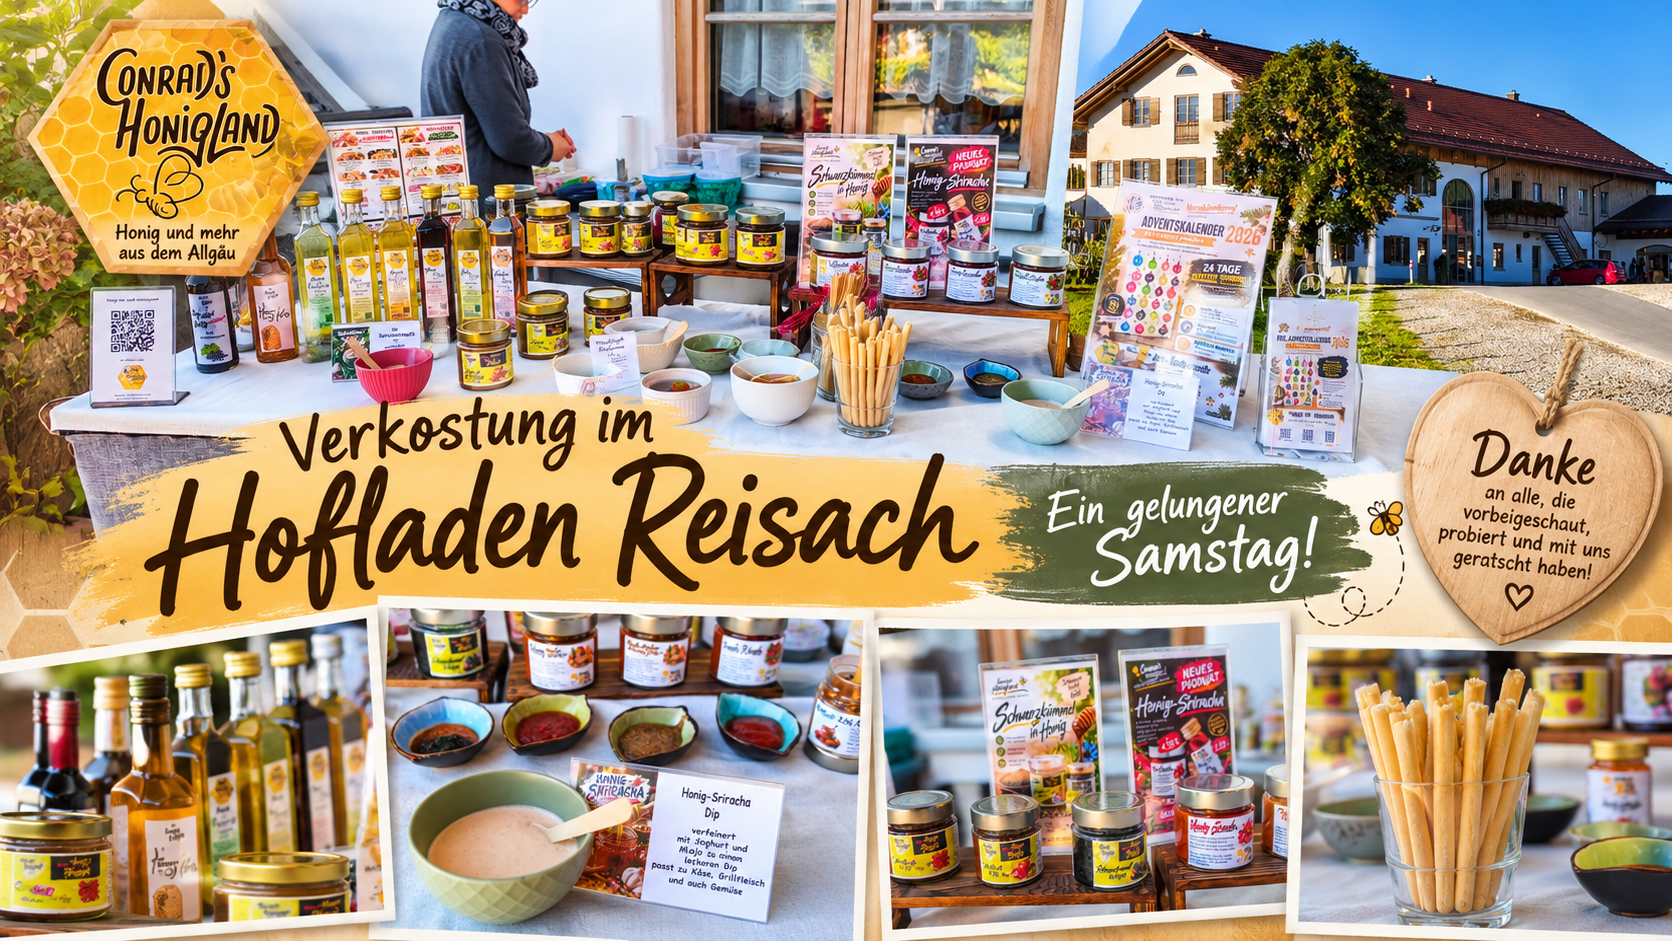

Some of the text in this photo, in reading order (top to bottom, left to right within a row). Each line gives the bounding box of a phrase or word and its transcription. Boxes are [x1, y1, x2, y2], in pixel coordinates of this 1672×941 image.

[1141, 215, 1225, 237] ADVENTSKALENDER
[1225, 225, 1262, 246] 2026
[1202, 263, 1242, 275] 24 TAGE
[681, 787, 752, 808] Honig-Sriracha
[704, 807, 720, 821] Dip
[691, 828, 737, 841] verfeinert
[676, 836, 691, 844] mit
[732, 845, 749, 853] und
[651, 862, 675, 872] passt
[677, 866, 688, 874] zu
[718, 872, 766, 887] Grillfleisch
[668, 877, 743, 896] und auch Gemüse
